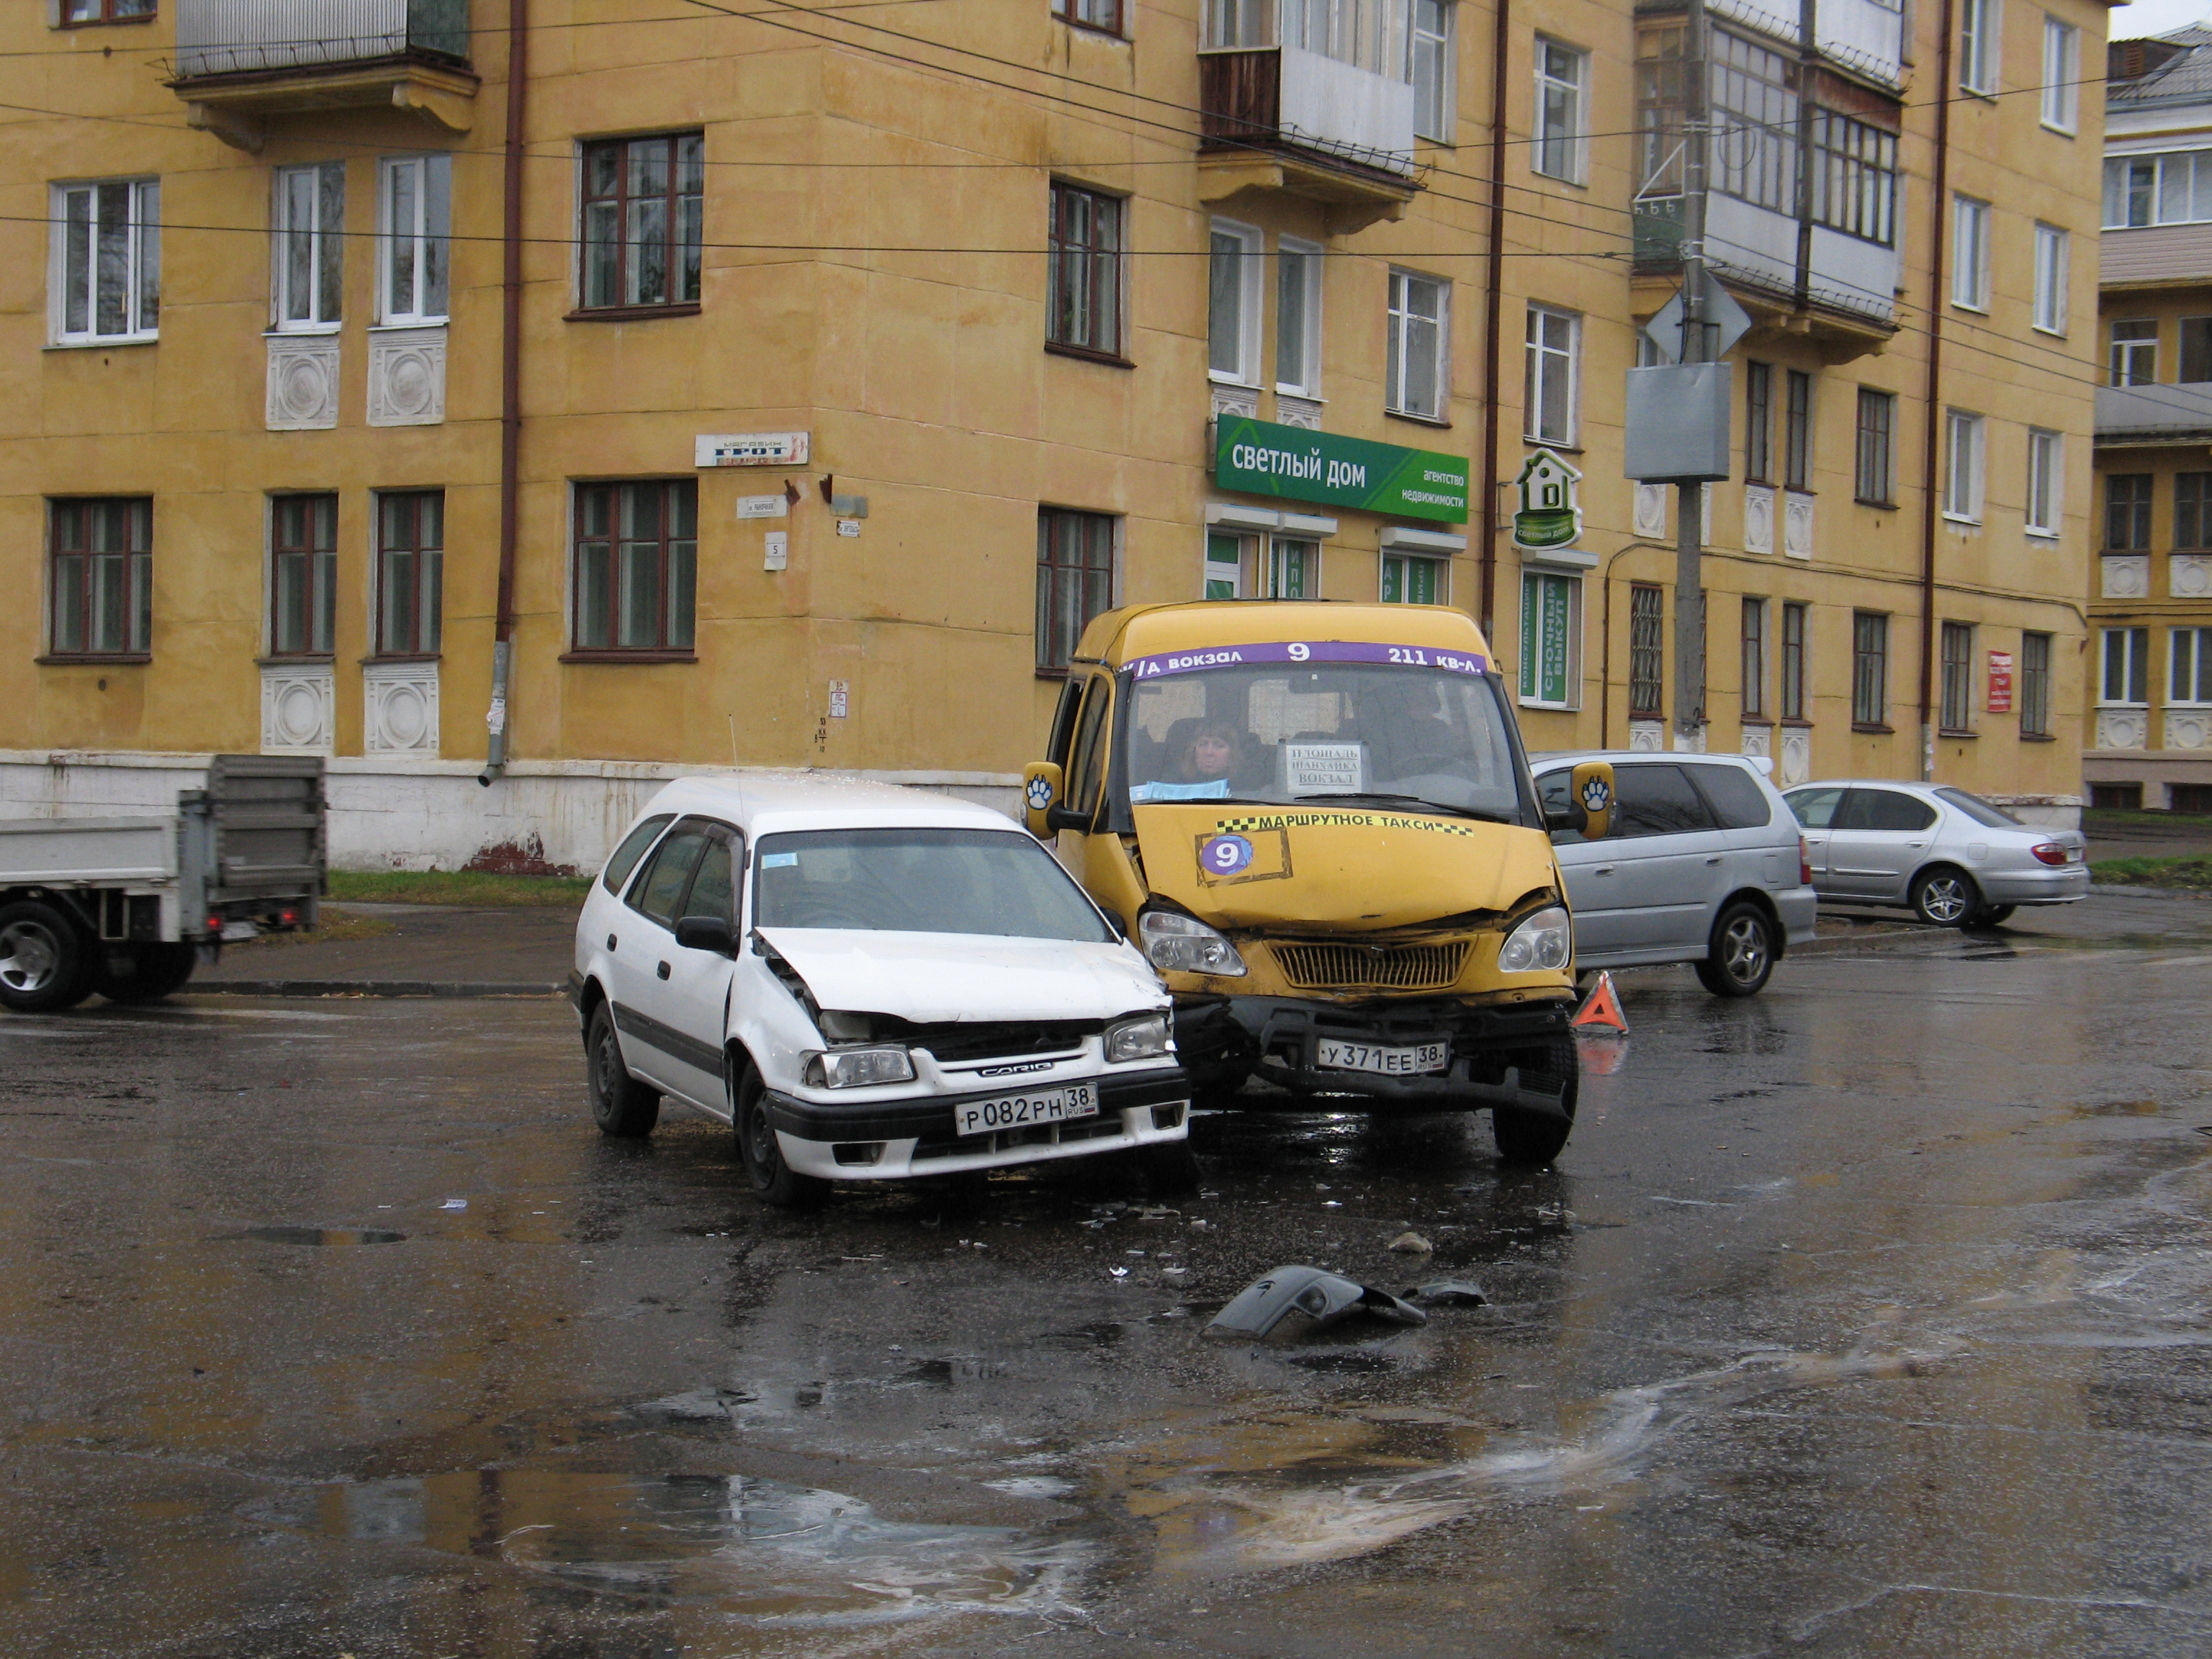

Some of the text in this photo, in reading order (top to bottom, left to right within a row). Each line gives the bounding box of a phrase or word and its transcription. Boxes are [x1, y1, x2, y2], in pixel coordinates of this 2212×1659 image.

[714, 447, 788, 456] ГРОТ
[1424, 469, 1465, 487] агентство
[1402, 489, 1464, 508] недвижимости
[773, 545, 778, 554] 5
[1545, 582, 1556, 692] СРОЧНЫЙ
[1554, 600, 1564, 676] ВЫКУП
[1287, 642, 1310, 662] 9
[1388, 648, 1428, 665] 211
[1292, 750, 1357, 758] ПЛОЩАДЬ
[1292, 760, 1358, 769] ШАНХАЙКА
[1298, 773, 1353, 783] ВОКЗАЛ
[1259, 814, 1436, 832] МАРШРУТНОЕ ТАКСИ
[1215, 843, 1239, 867] 9
[1328, 1046, 1437, 1071] У371ЕЕ 38
[981, 1062, 1053, 1076] CARIB
[966, 1088, 1089, 1130] Р082РН 38
